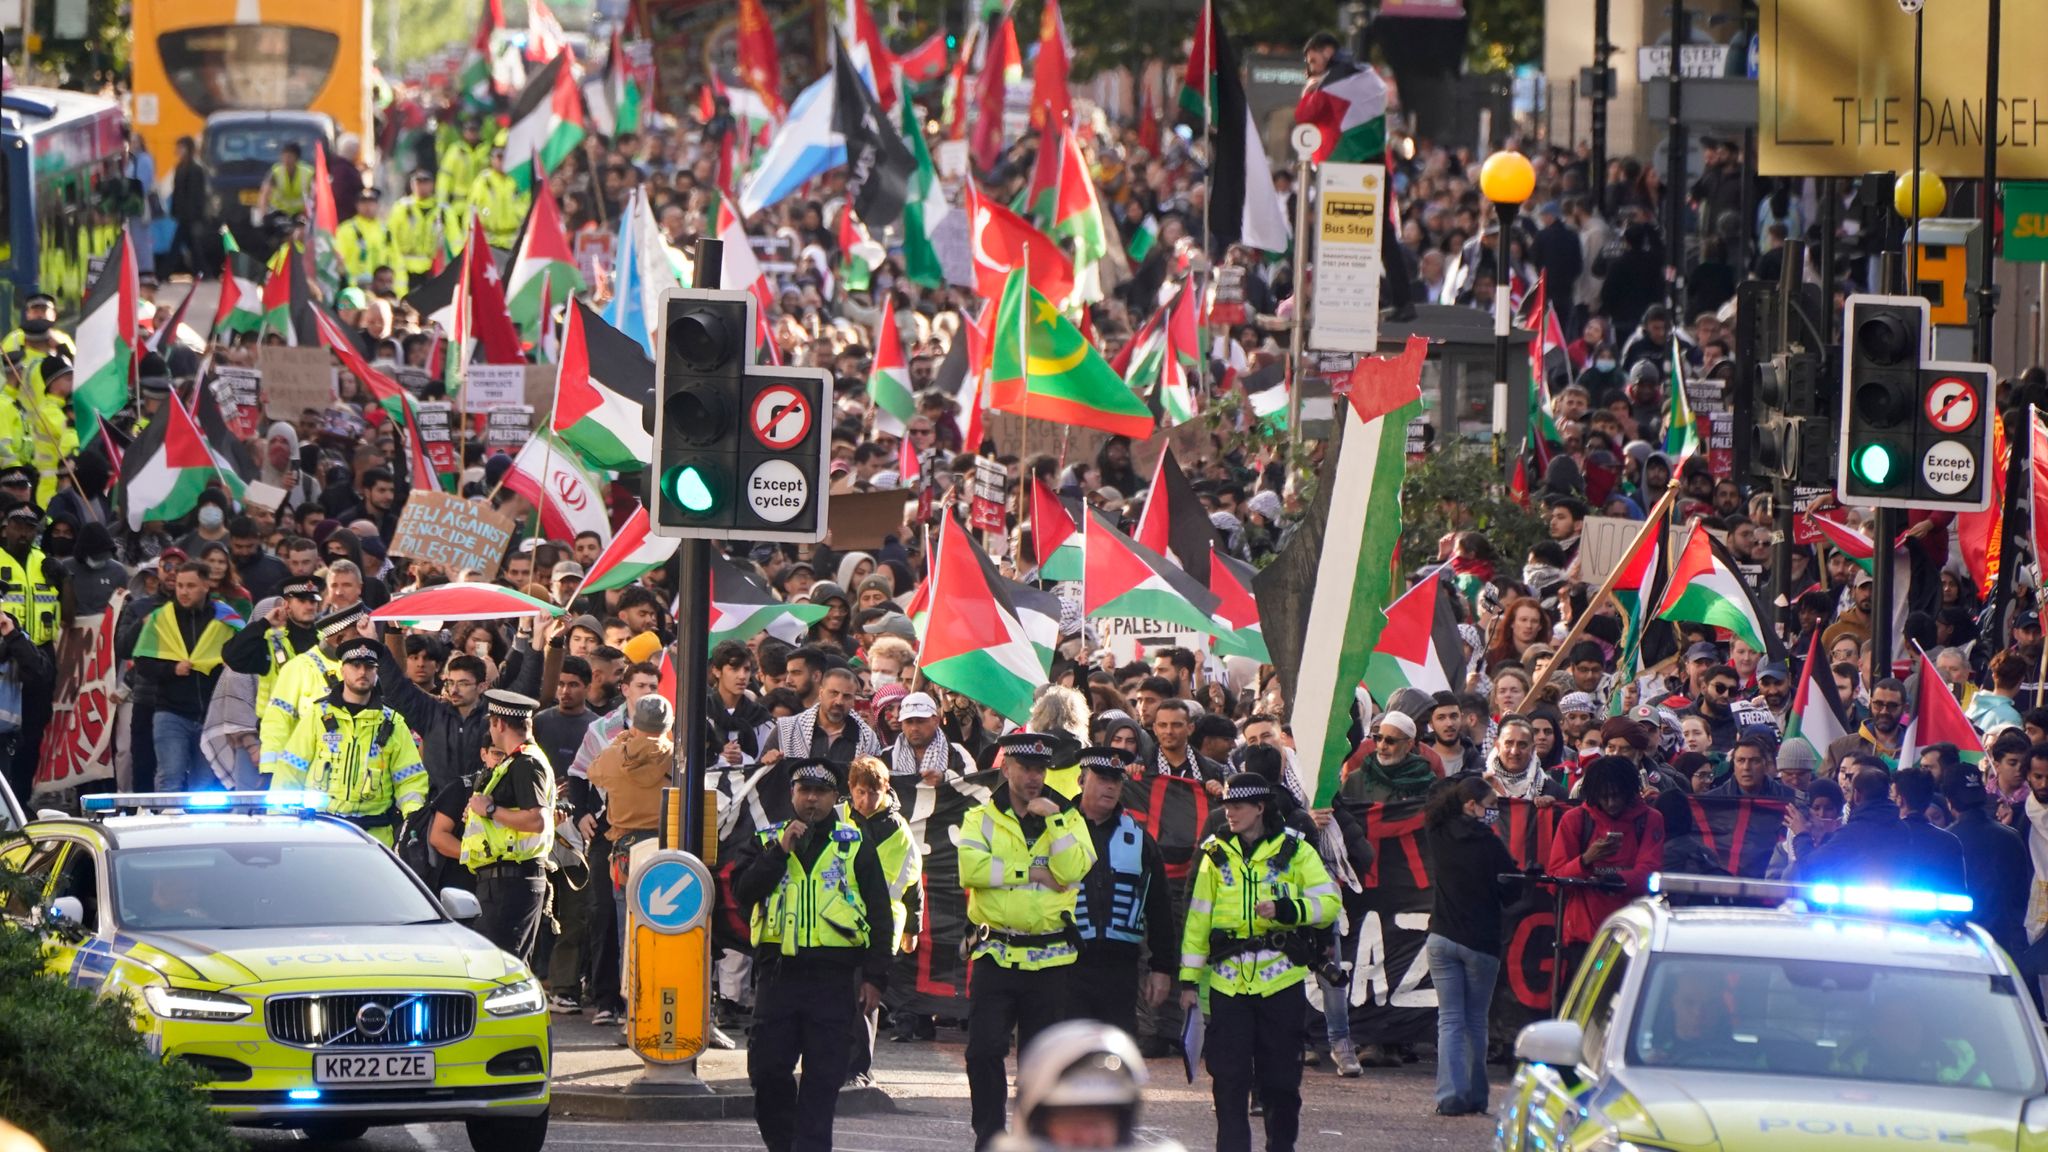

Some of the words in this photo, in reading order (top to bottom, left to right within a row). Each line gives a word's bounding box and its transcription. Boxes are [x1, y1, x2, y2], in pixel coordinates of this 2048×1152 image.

[1650, 48, 1722, 63] CHSTER
[1833, 97, 1900, 146] THE
[1300, 129, 1313, 148] C
[1324, 223, 1345, 234] Bus
[1347, 224, 1373, 238] Stop
[490, 413, 530, 425] FREEDOM
[1928, 455, 1971, 470] Except
[1929, 470, 1968, 483] cycles
[753, 477, 803, 493] Except
[754, 494, 800, 508] cycles
[469, 506, 478, 517] A
[403, 503, 440, 521] JEW
[441, 511, 510, 548] AGAINST
[397, 521, 476, 550] GENOCIDE
[482, 543, 502, 564] IN
[399, 535, 487, 570] PALESTINE
[265, 951, 445, 966] POLICE
[325, 1057, 380, 1077] KR22
[386, 1056, 426, 1076] CZE
[1759, 1115, 1969, 1145] POLICE
